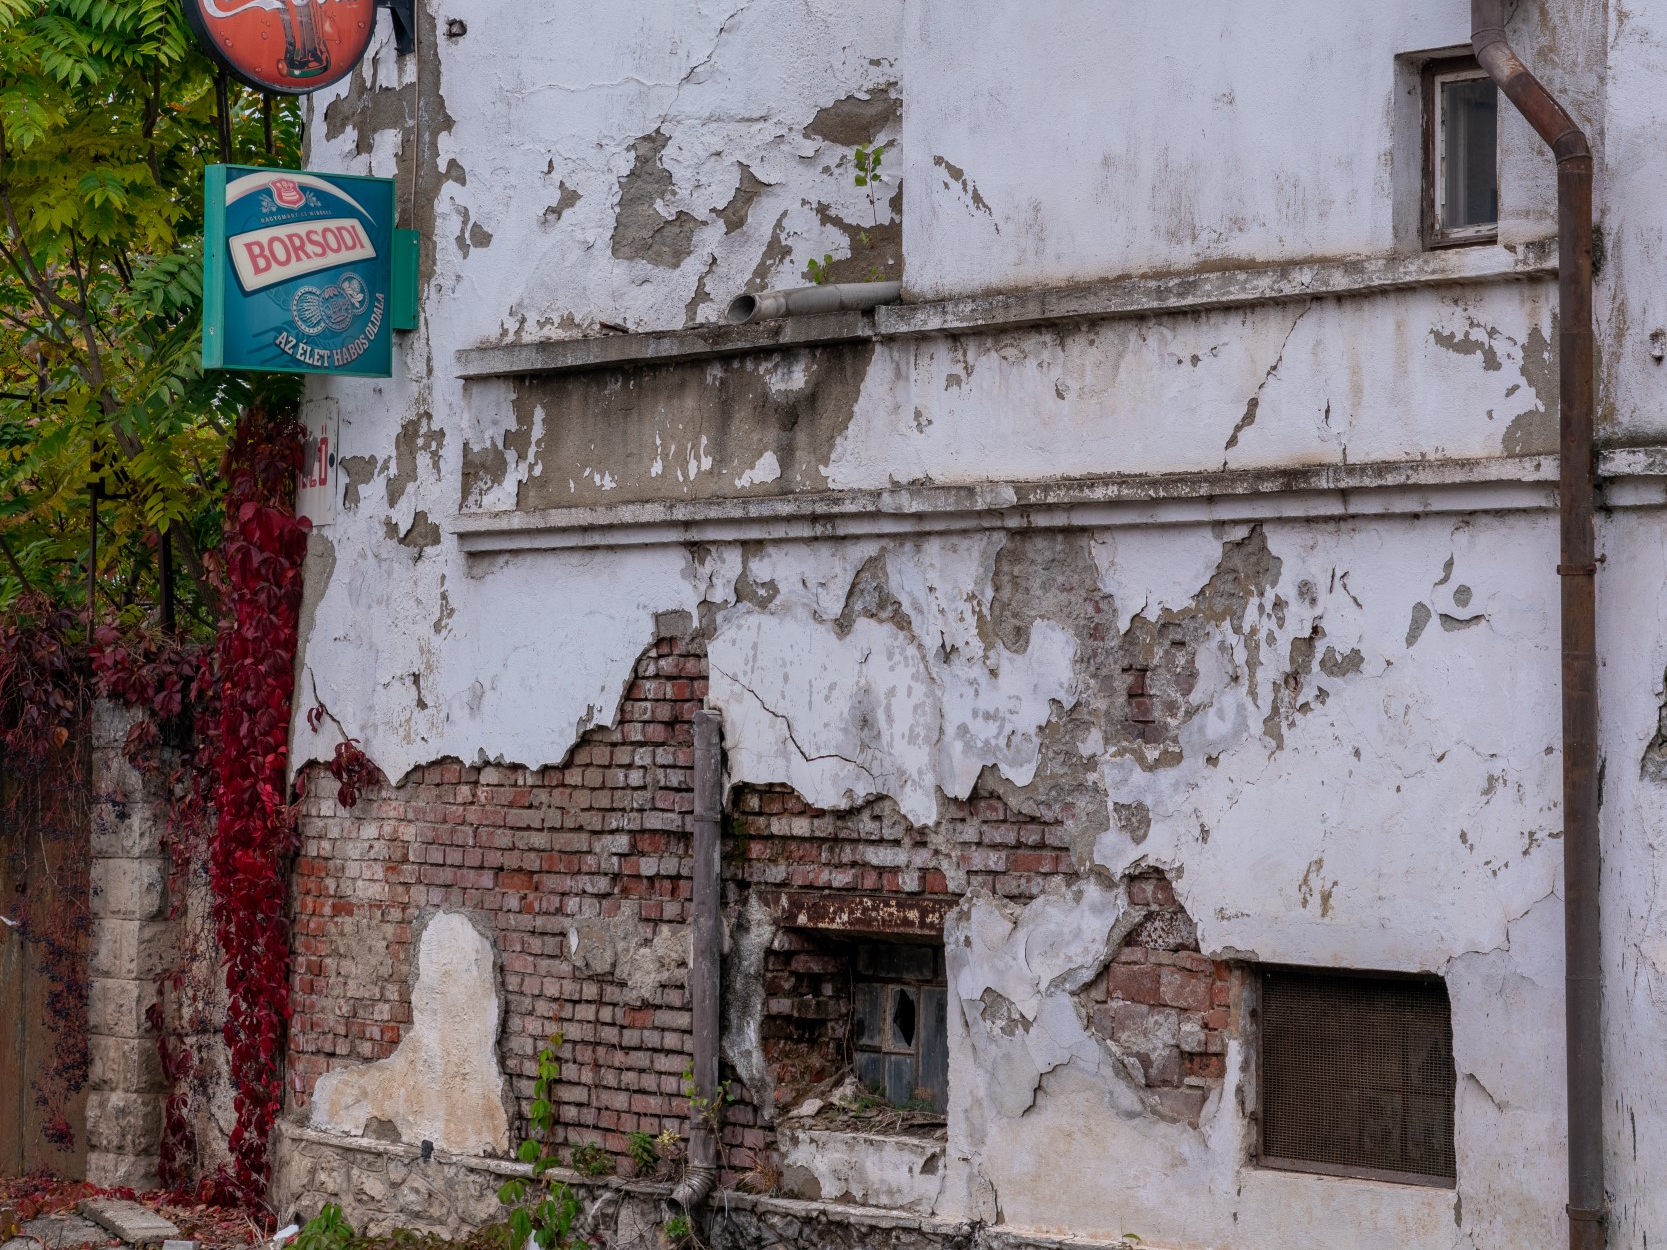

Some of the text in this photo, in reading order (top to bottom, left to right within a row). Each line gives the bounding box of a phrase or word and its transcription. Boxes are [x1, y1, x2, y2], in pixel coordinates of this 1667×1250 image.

[243, 225, 366, 277] BORSODI
[275, 293, 385, 367] AZ ÉLET HABOS OLDALA
